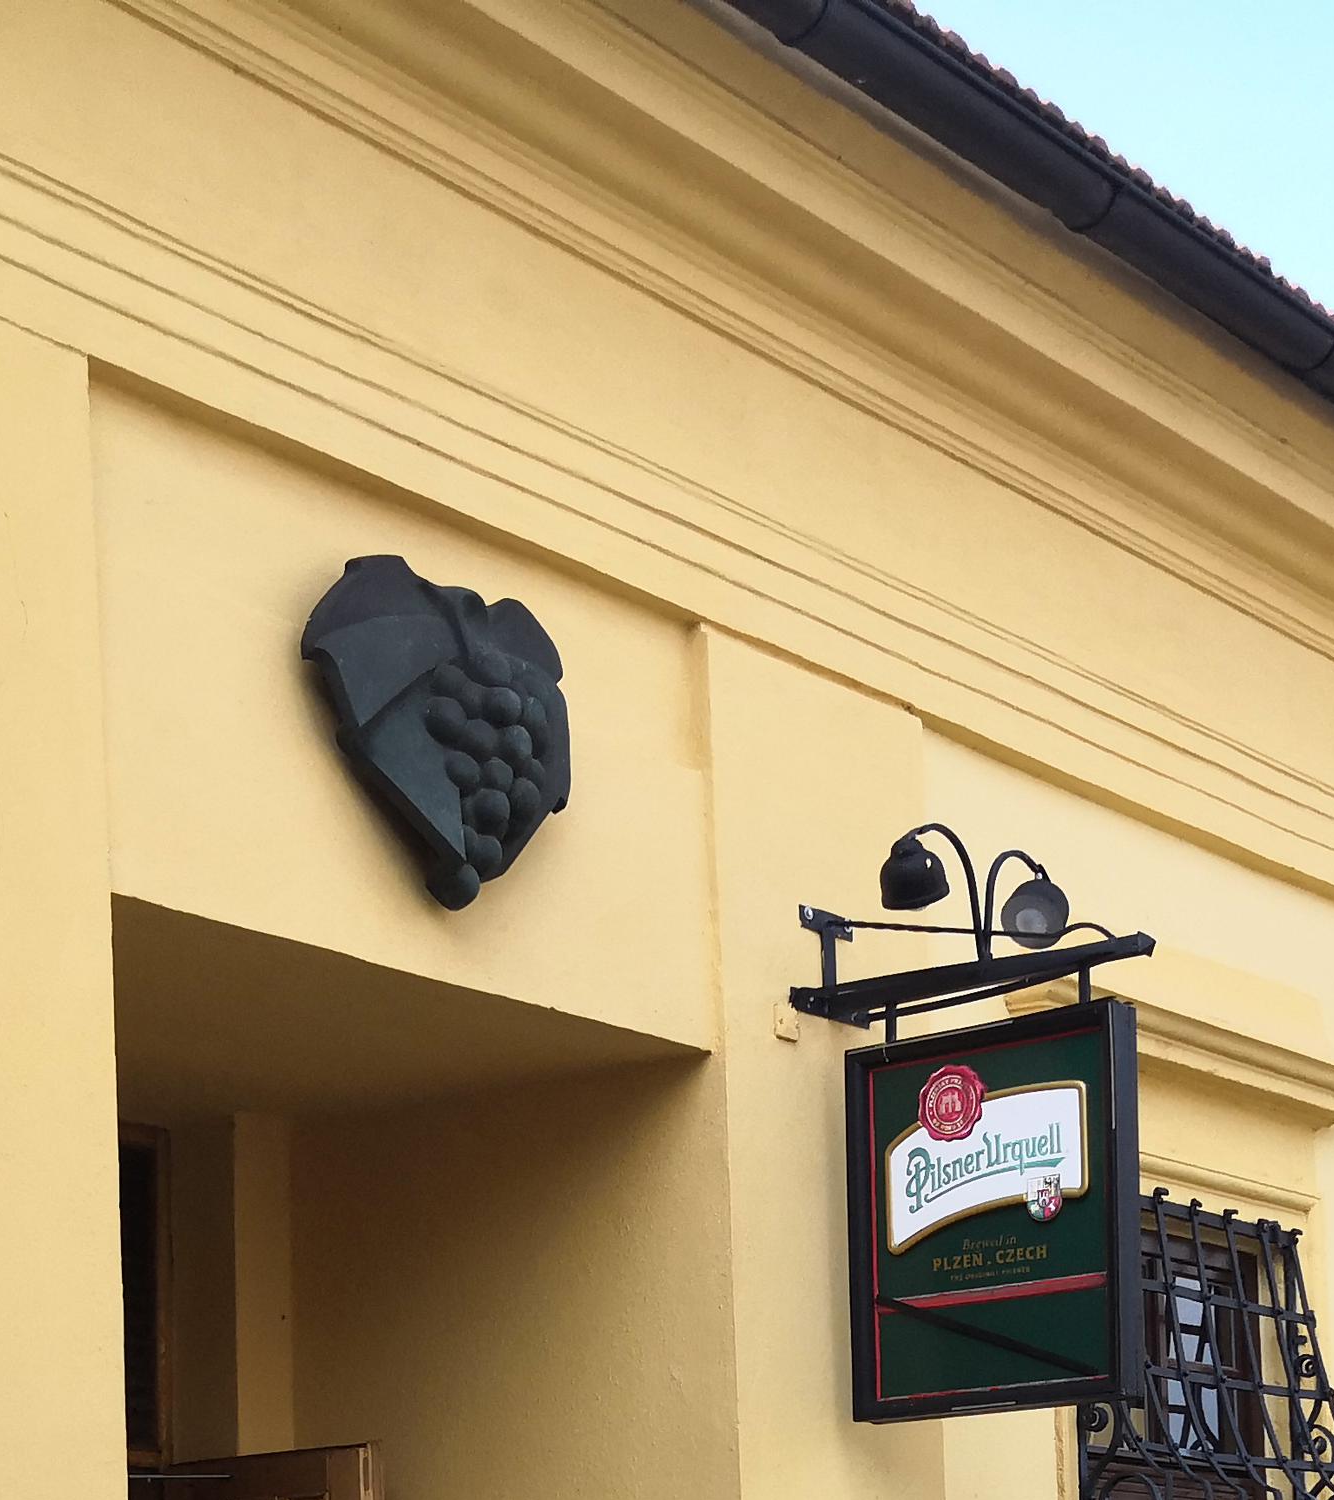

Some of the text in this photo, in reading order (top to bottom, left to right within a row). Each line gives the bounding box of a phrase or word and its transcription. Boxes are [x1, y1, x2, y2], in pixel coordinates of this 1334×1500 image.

[906, 1122, 1062, 1214] Pilsner Urquell
[995, 1244, 1047, 1265] CZECH
